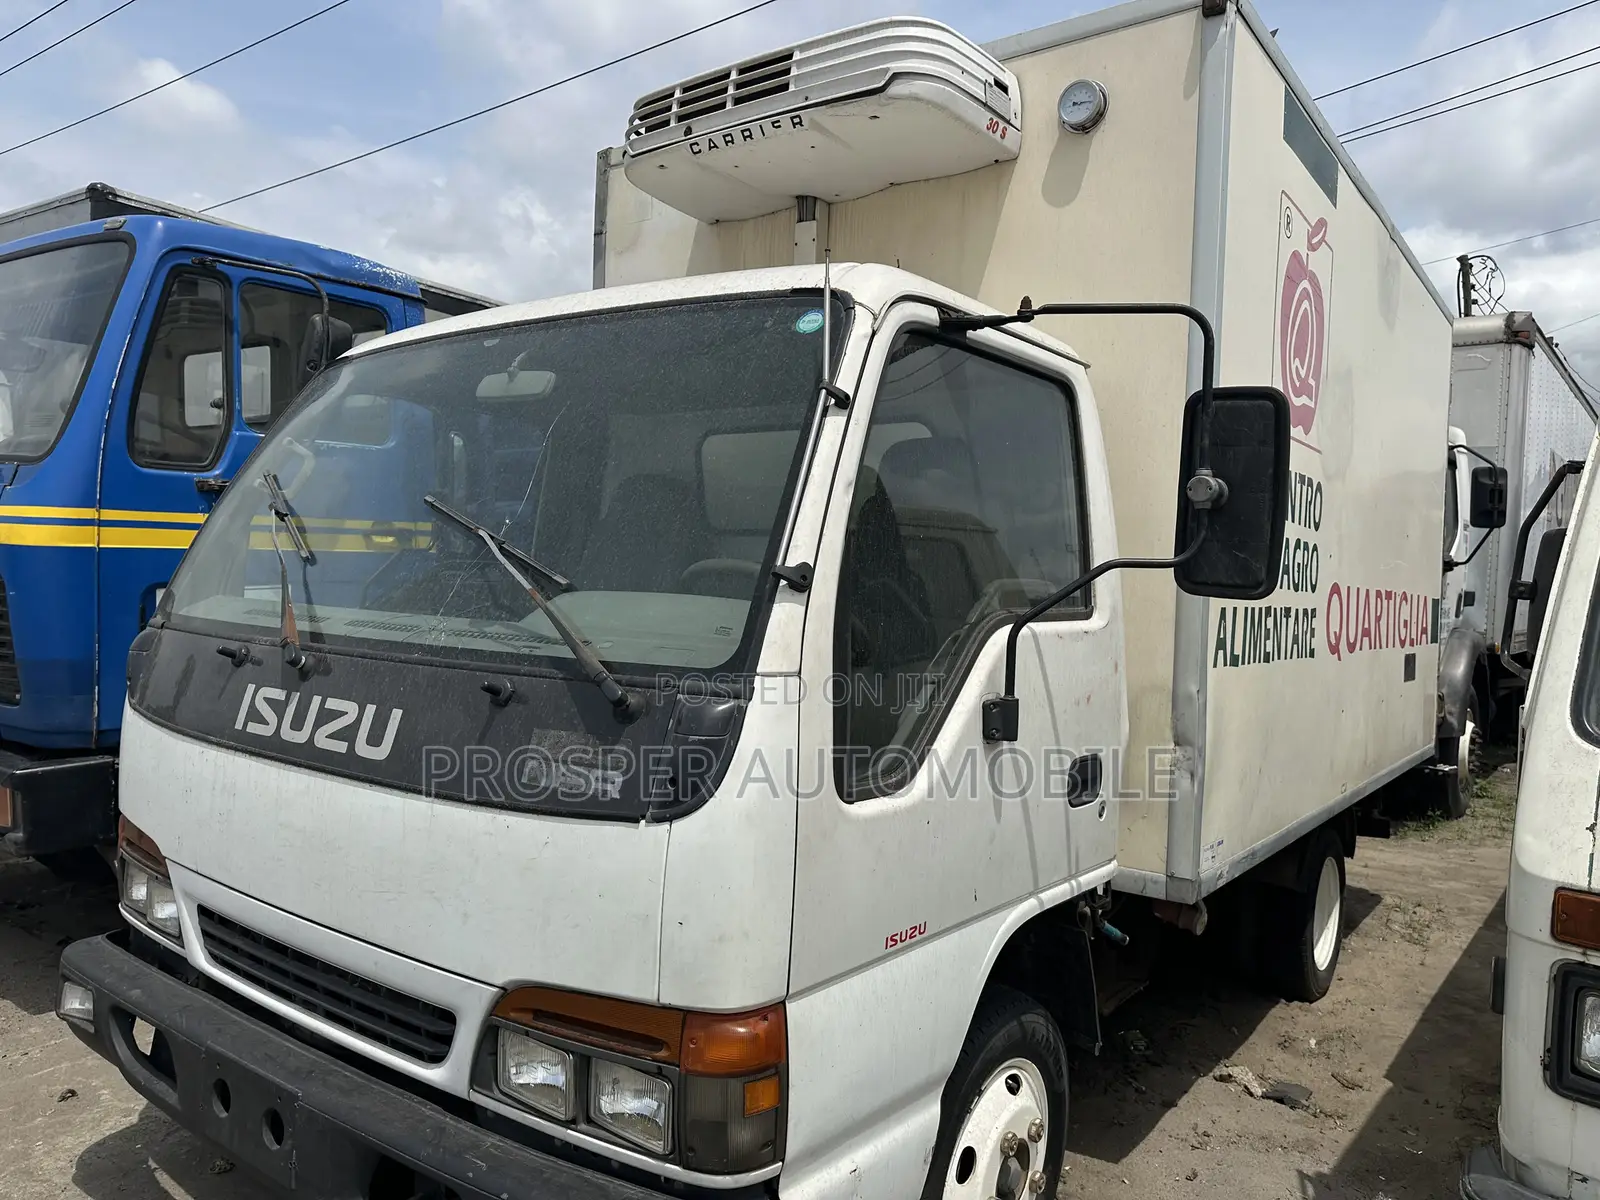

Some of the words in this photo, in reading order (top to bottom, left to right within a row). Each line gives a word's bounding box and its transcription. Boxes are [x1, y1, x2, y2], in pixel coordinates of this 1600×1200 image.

[986, 117, 999, 134] 30
[1000, 126, 1008, 139] S
[1286, 470, 1323, 531] NTRO
[1280, 537, 1319, 593] AGRO
[1213, 606, 1317, 668] ALIMENTARE
[1326, 582, 1429, 661] QUARTIGLIA
[234, 683, 404, 761] ISUZU
[885, 921, 927, 950] ISUZU
